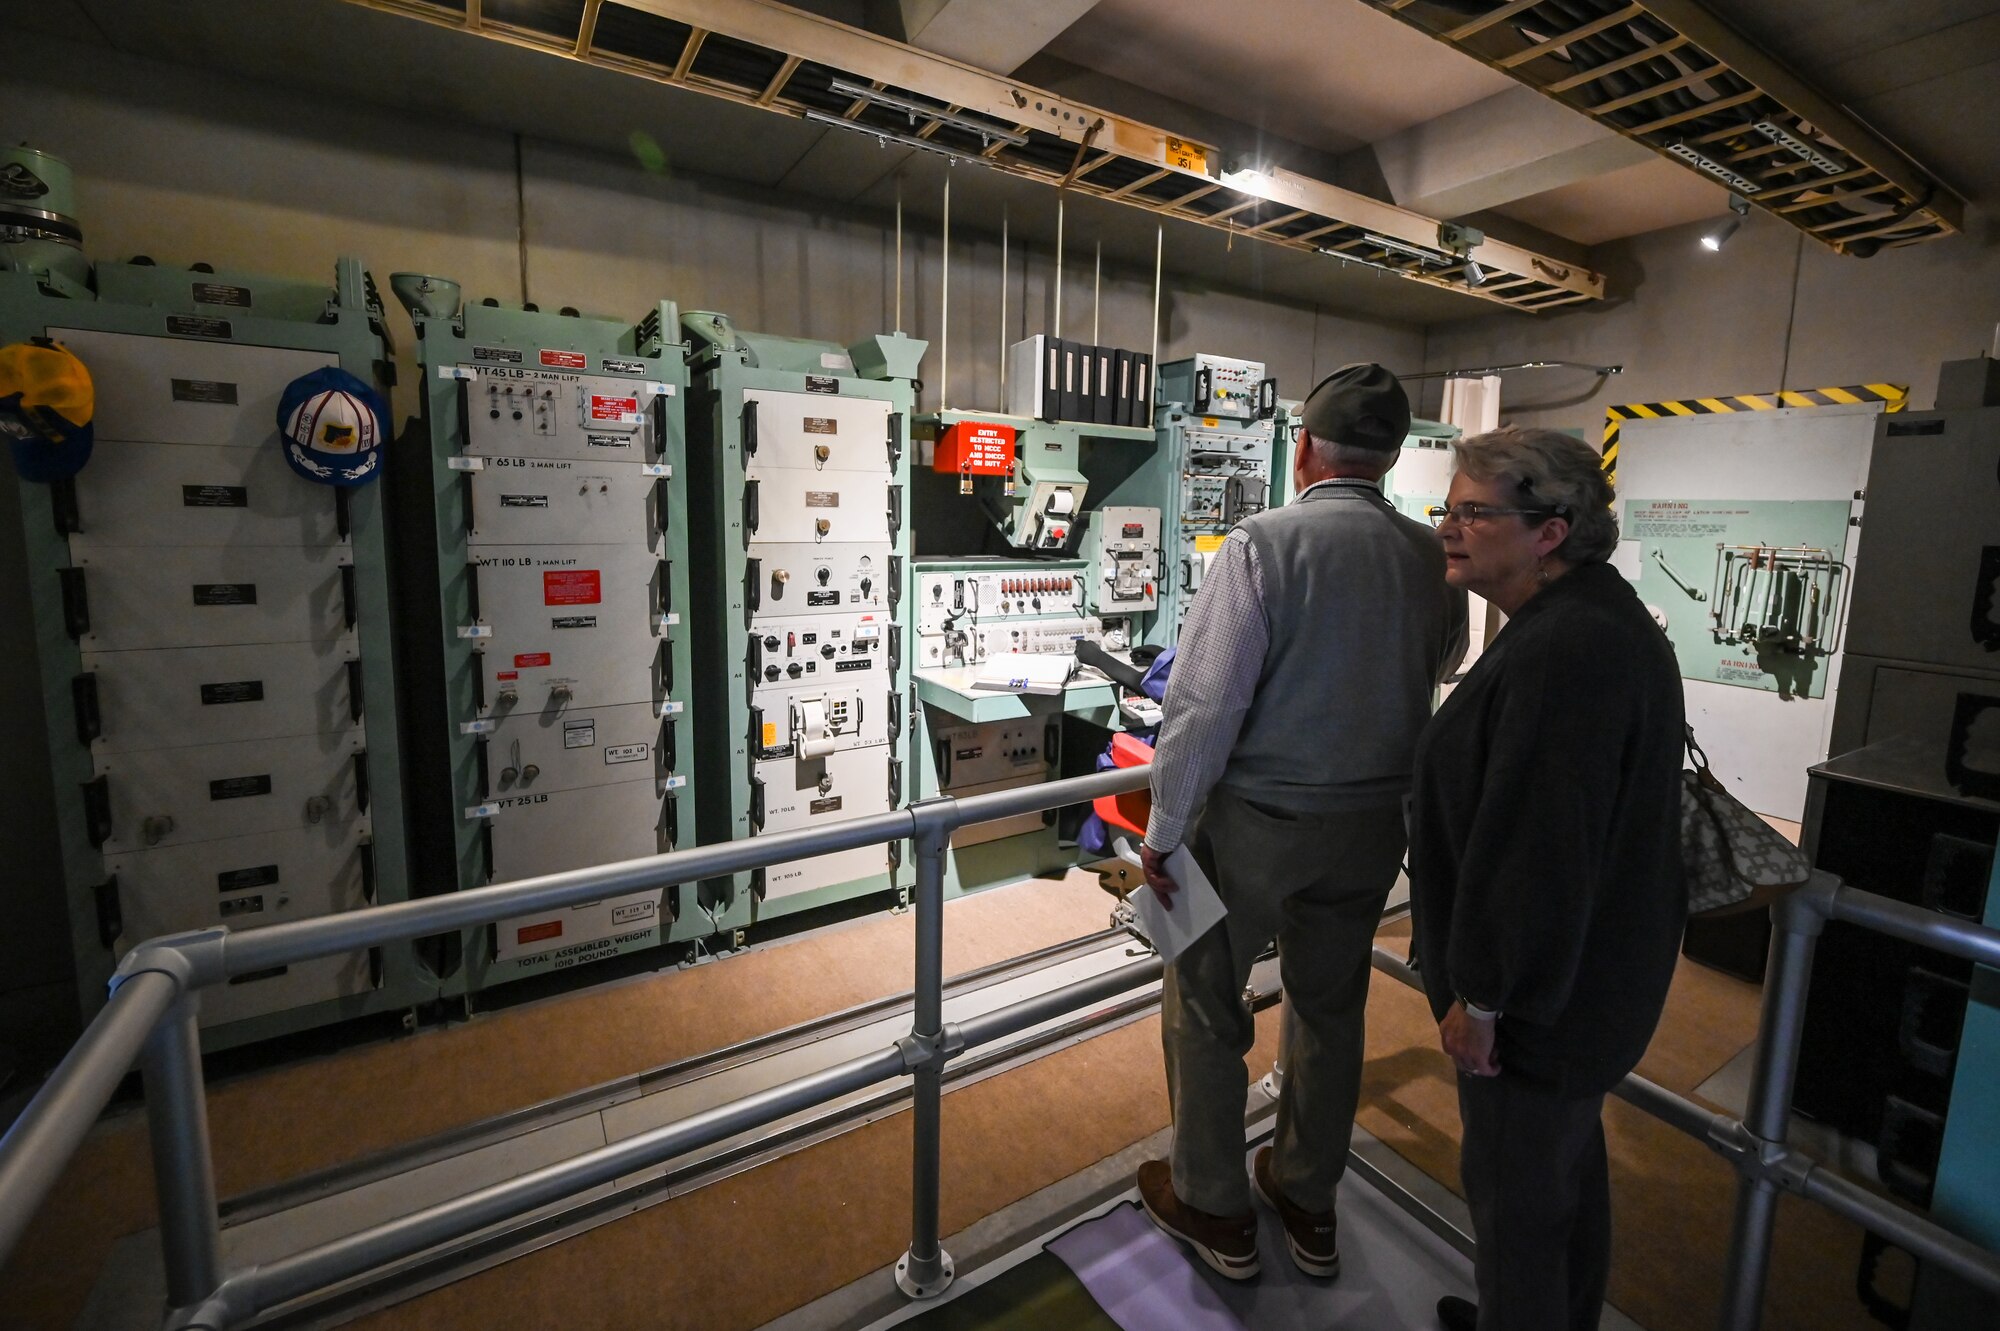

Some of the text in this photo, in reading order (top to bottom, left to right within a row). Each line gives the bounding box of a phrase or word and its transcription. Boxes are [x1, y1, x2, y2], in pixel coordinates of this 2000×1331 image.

[1177, 157, 1192, 170] 351
[491, 368, 506, 377] 45
[508, 369, 524, 378] LB
[978, 429, 998, 437] ENTRY
[496, 458, 510, 467] 65
[512, 459, 526, 468] LB
[1652, 502, 1688, 510] WARNING
[480, 558, 498, 566] WT
[502, 558, 515, 566] 110
[519, 558, 532, 566] LB
[518, 798, 531, 806] 25
[534, 795, 548, 804] LB
[517, 930, 653, 968] TOTAL ASSEMBLED WEIGHT
[554, 948, 618, 968] 1010 POUNDS
